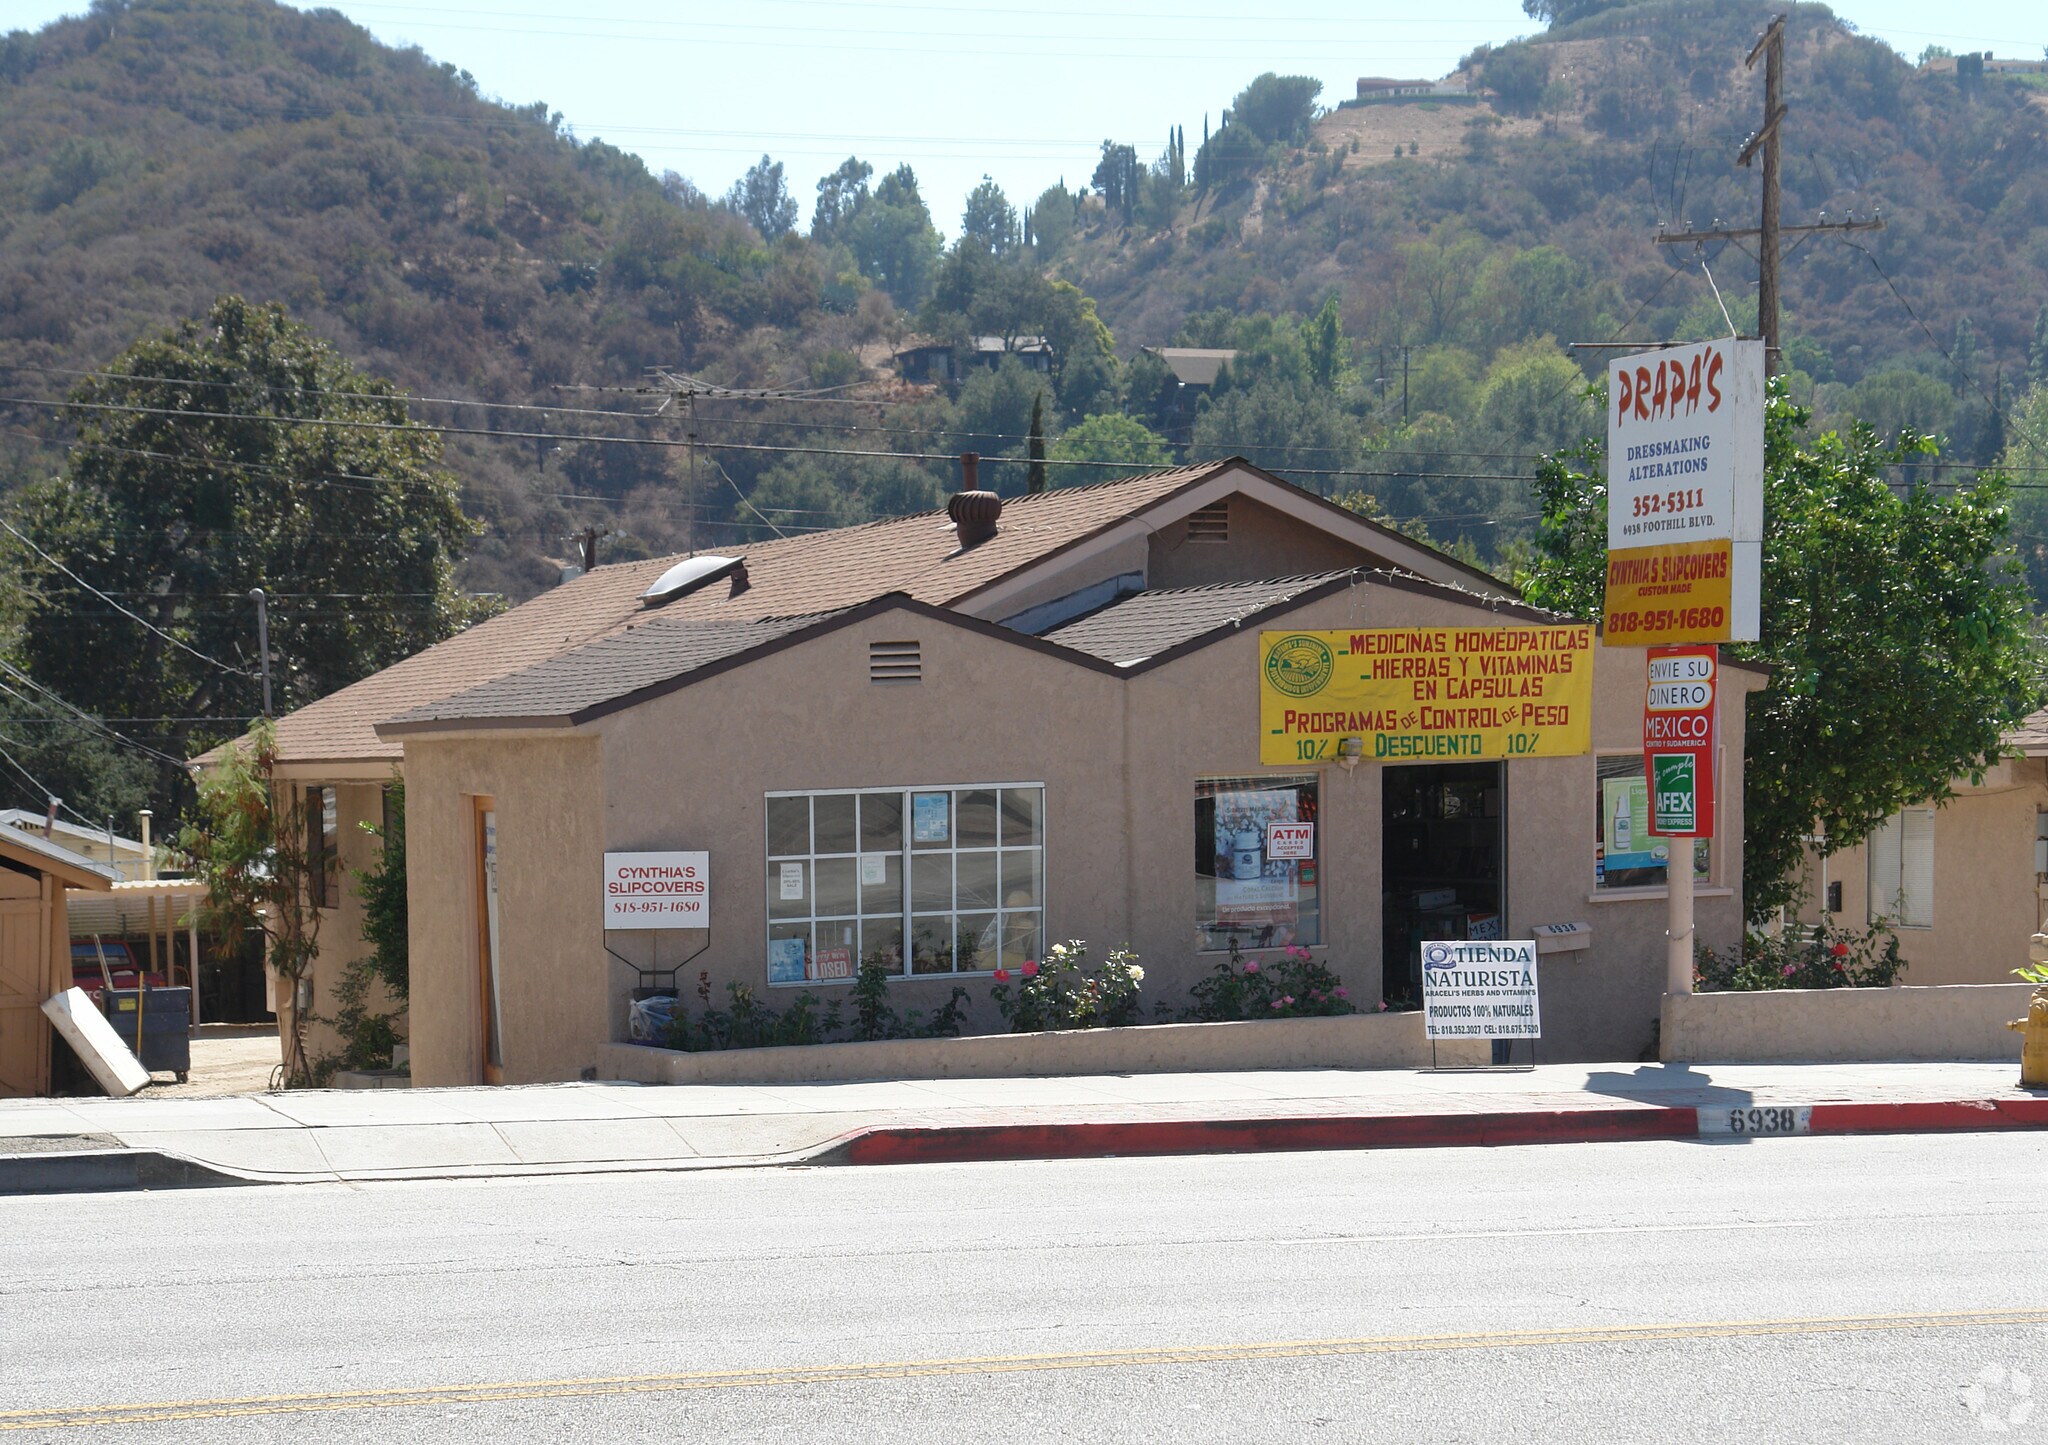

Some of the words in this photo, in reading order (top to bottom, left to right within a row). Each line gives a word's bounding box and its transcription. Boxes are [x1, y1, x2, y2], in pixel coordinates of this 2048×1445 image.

[1618, 345, 1723, 428] PRAPA'S
[1627, 435, 1711, 461] DRESSMAKING
[1628, 457, 1708, 481] ALTERATIONS
[1633, 488, 1704, 517] 352-5311
[1623, 523, 1641, 535] 6938
[1643, 518, 1686, 533] FOOTHILL
[1689, 515, 1715, 528] BLVD.
[1662, 551, 1728, 583] SLIPCOVERS
[1638, 585, 1669, 597] CUSTOM
[1670, 583, 1692, 594] MADE
[1608, 606, 1724, 633] 818-951-1680
[1350, 633, 1446, 655] MEDICINAS
[1455, 629, 1589, 652] HOMEOPATICAS
[1373, 657, 1450, 679] HIERBAS
[1458, 656, 1469, 676] Y
[1479, 653, 1572, 676] VITAMINAS
[1650, 662, 1680, 679] ENVIE
[1688, 661, 1709, 677] SU
[1413, 680, 1437, 700] EN
[1446, 677, 1543, 699] CAPSULAS
[1650, 686, 1706, 705] DINERO
[1284, 709, 1397, 733] PROGRAMAS
[1400, 711, 1418, 730] DE
[1420, 706, 1502, 730] CONTROL
[1502, 705, 1520, 724] DE
[1521, 703, 1569, 726] PESO
[1645, 715, 1708, 738] MEXICO
[1296, 739, 1328, 760] 10%
[1375, 733, 1482, 757] DESCUENTO
[1508, 733, 1540, 754] 10%
[1667, 739, 1707, 747] SUDAMERICA
[1656, 792, 1692, 812] AFEX
[1272, 829, 1309, 840] ATM
[618, 866, 696, 879] CYNTHIA'S
[608, 881, 705, 894] SLIPCOVERS
[613, 901, 700, 914] 818-951-1680
[1231, 905, 1256, 913] producto
[1548, 923, 1577, 934] 6938
[1455, 947, 1531, 963] TIENDA
[1425, 970, 1534, 988] NATURISTA
[1429, 1005, 1471, 1018] PRODUCTOS
[1473, 1004, 1491, 1018] 100%
[1493, 1004, 1534, 1017] NATURALES
[1427, 1025, 1440, 1034] TEL:
[1484, 1024, 1497, 1034] CEL:
[1730, 1108, 1795, 1133] 6938
